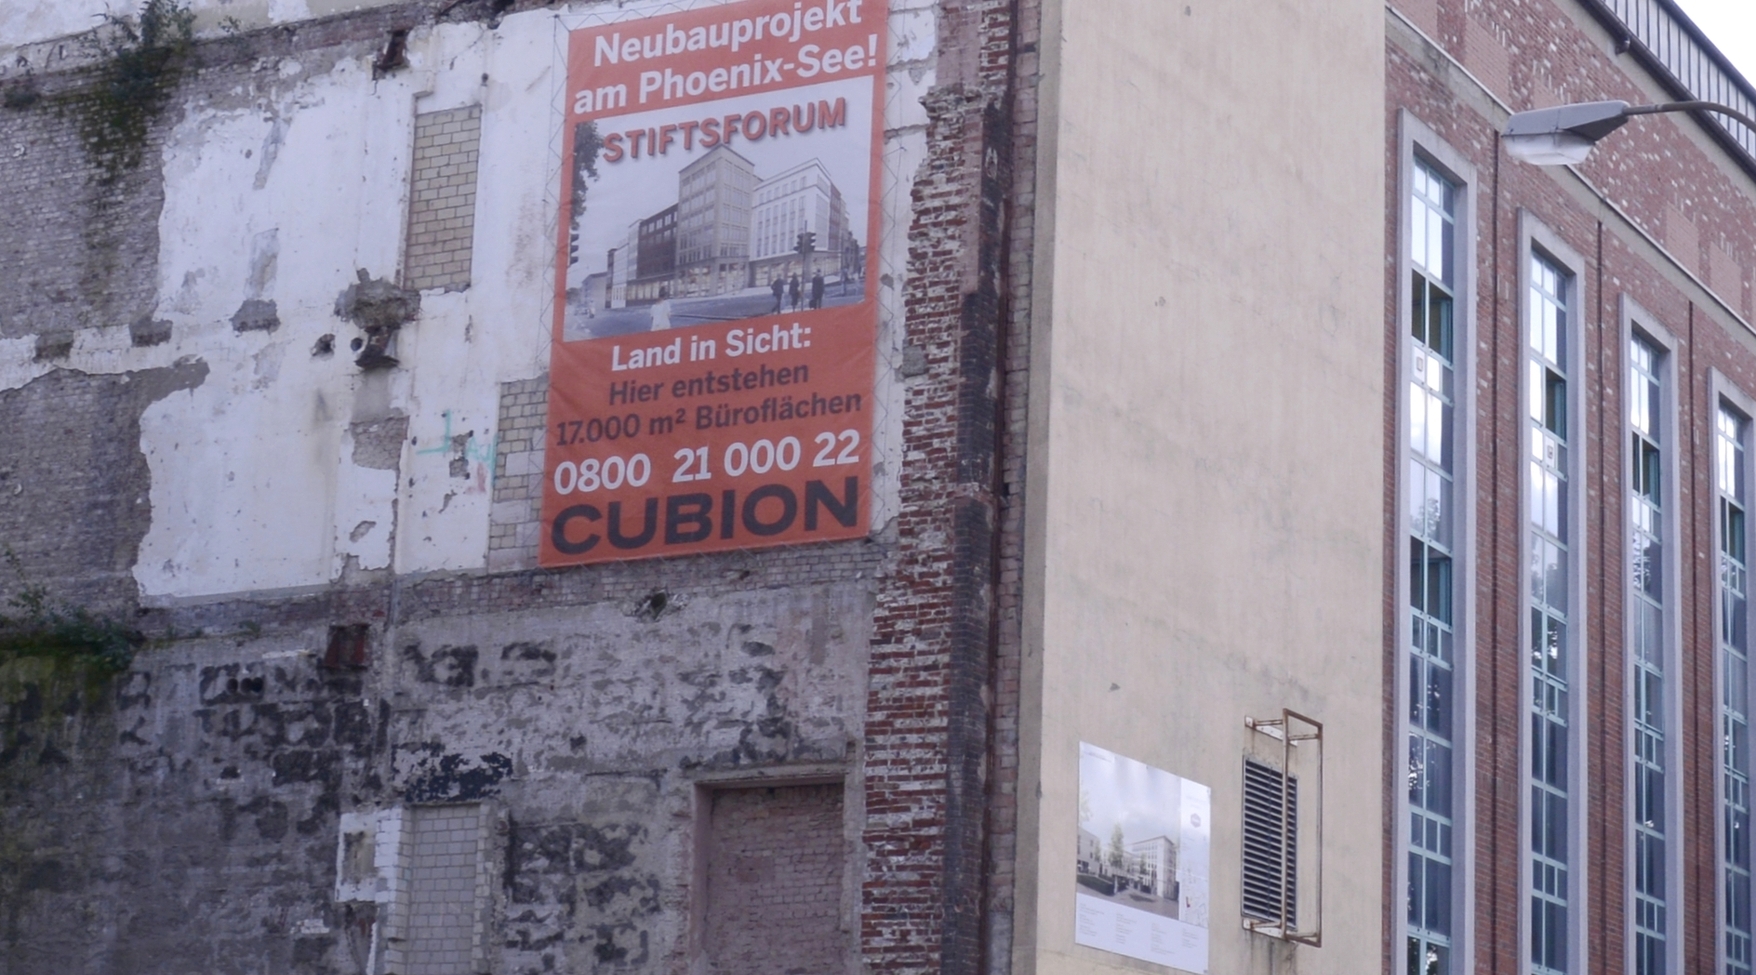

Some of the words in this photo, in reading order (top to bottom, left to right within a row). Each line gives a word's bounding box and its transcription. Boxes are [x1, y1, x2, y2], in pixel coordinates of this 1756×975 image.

[594, 0, 862, 67] Neubauprojekt
[573, 83, 627, 114] am
[639, 33, 878, 103] Phoenix-See!
[602, 97, 847, 163] STIFTSFORUM
[611, 338, 682, 371] Land
[690, 335, 716, 362] in
[725, 322, 811, 358] Sicht:
[609, 379, 664, 406] Hier
[671, 364, 808, 399] entstehen
[556, 414, 640, 446] 17.000
[650, 408, 686, 436] m²
[695, 392, 861, 430] Büroflächen
[553, 453, 651, 495] 0800
[671, 446, 712, 484] 21
[723, 436, 801, 477] 000
[812, 429, 860, 468] 22
[551, 475, 859, 555] CUBION
